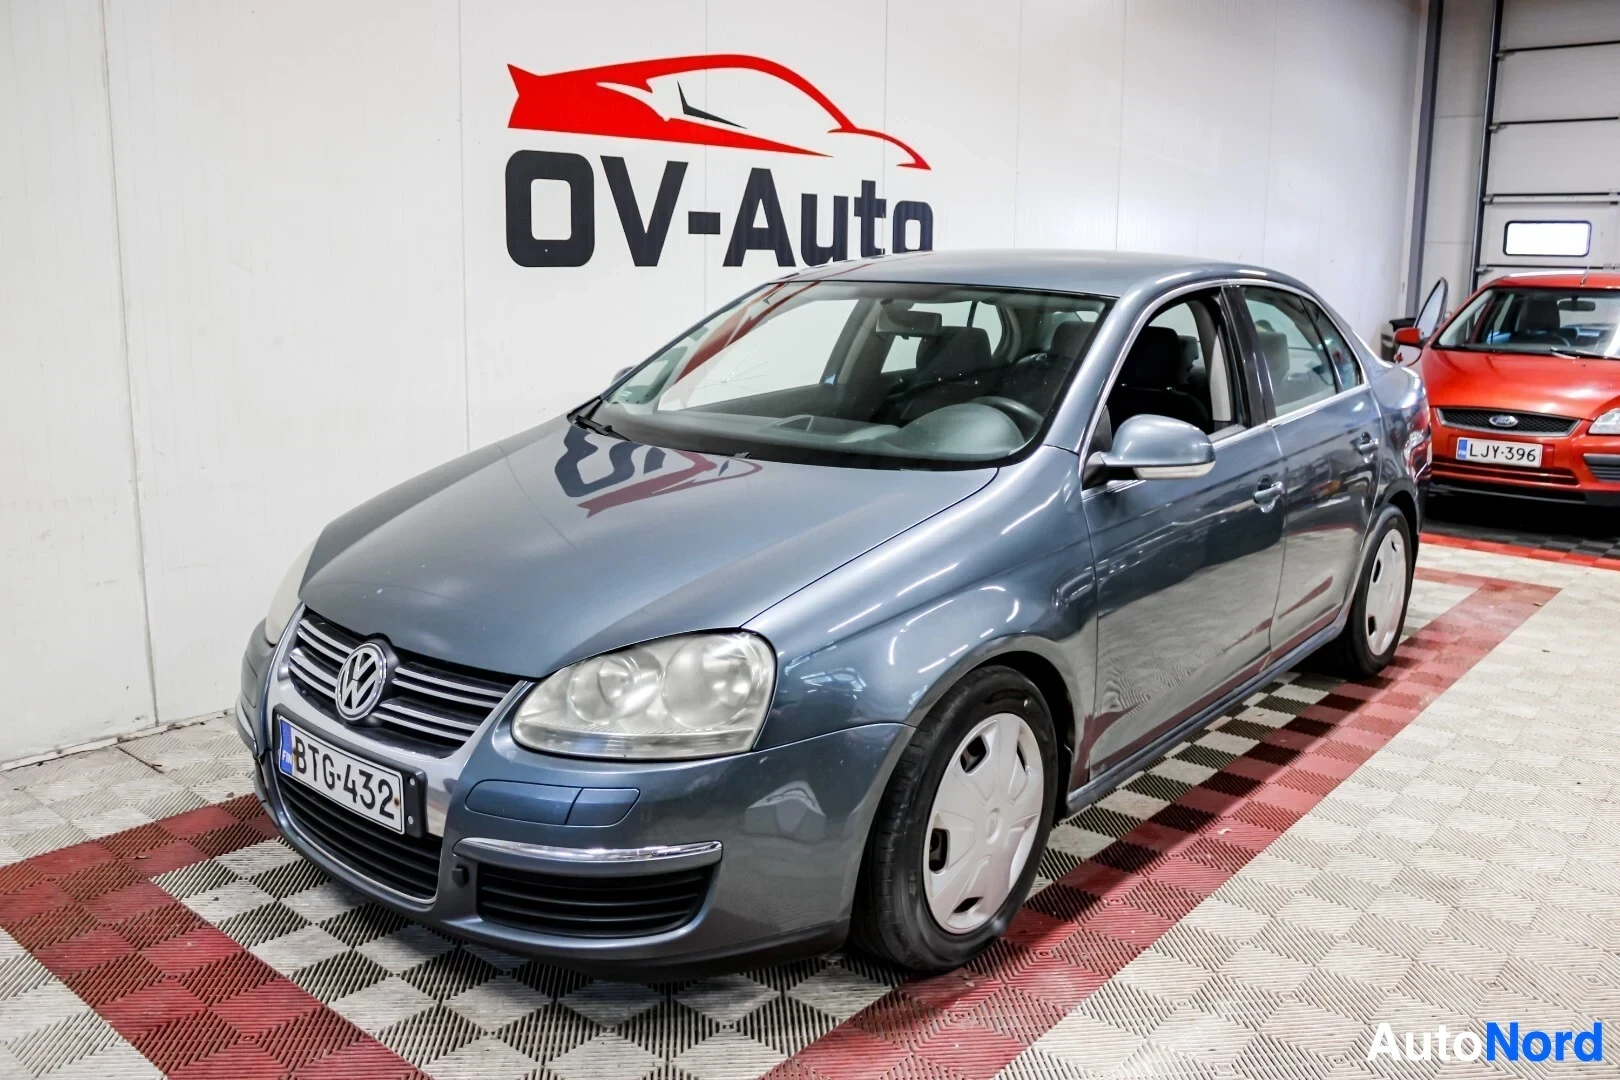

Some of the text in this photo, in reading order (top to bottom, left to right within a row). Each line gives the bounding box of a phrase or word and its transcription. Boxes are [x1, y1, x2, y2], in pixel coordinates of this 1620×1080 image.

[505, 149, 933, 267] OV-Auto
[1469, 443, 1536, 462] LJY-396
[295, 735, 395, 820] BTG-432
